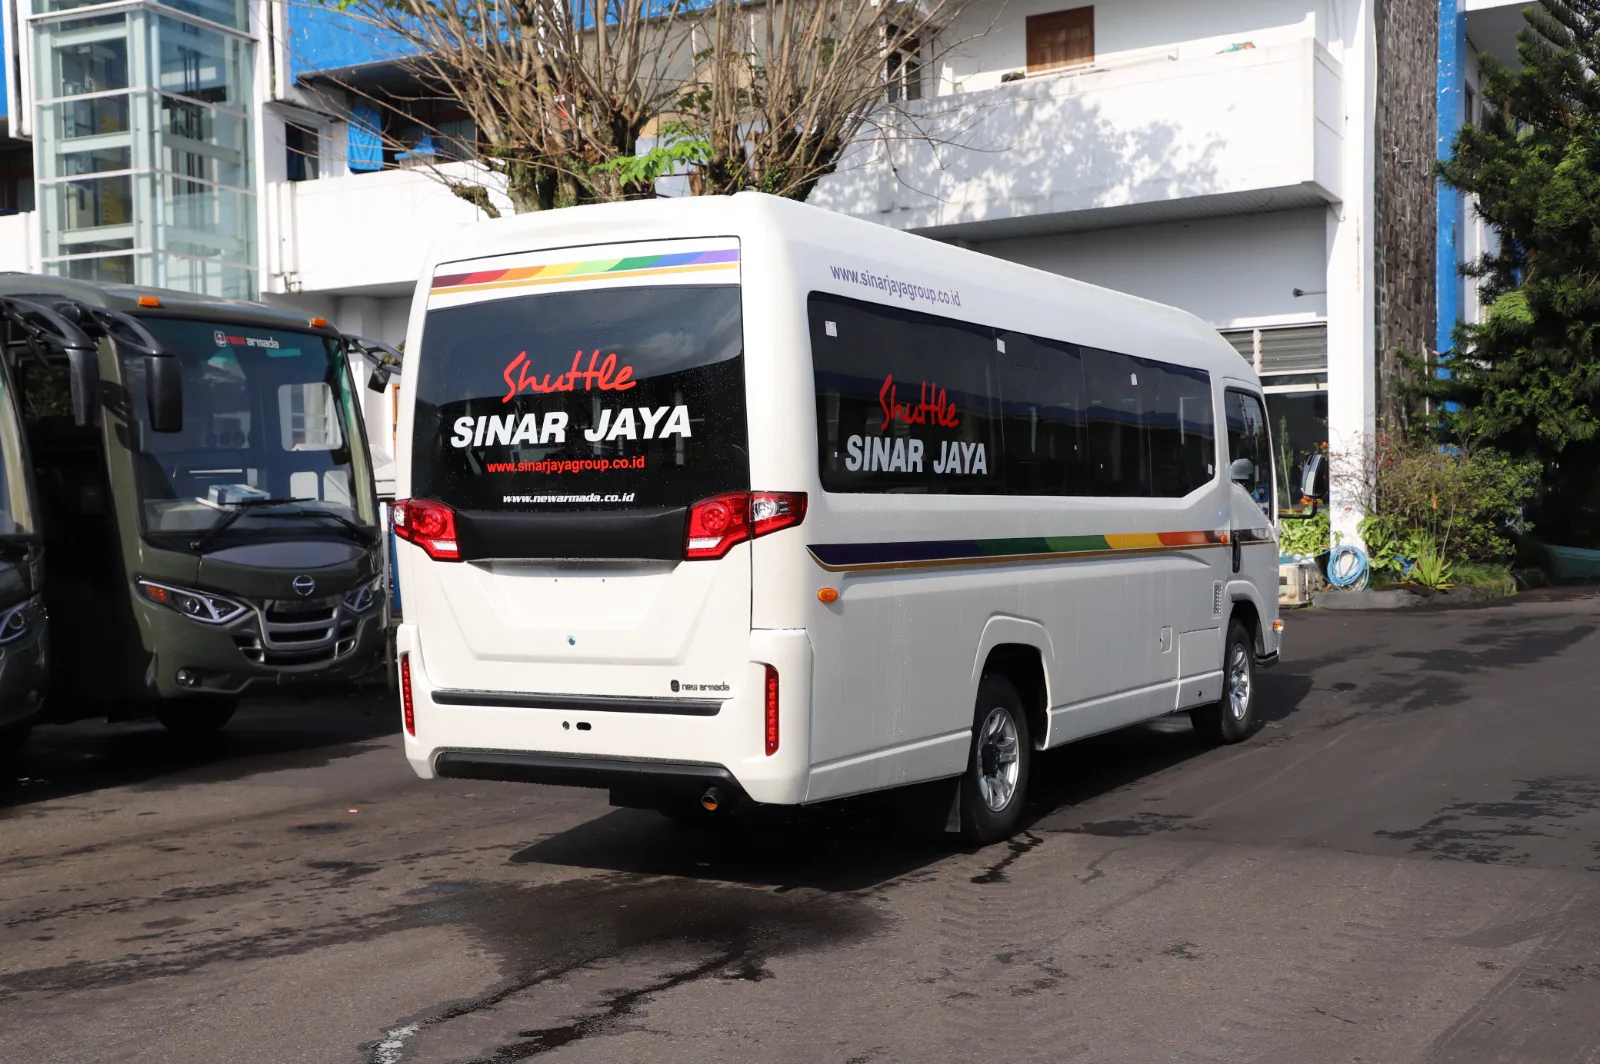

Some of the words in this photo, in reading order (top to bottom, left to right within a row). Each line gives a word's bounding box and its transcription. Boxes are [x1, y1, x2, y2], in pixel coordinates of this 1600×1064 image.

[830, 264, 961, 307] www.sinarjayagroup.co.id
[246, 336, 279, 349] armada
[503, 350, 637, 403] Shuttle
[880, 374, 960, 431] Shuttle
[450, 411, 569, 448] SINAR
[584, 404, 692, 443] JAYA
[487, 456, 646, 475] www.sinarjayagroup.co.id
[845, 434, 924, 473] SINAR
[933, 440, 988, 475] JAYA
[502, 493, 636, 504] www.newarmada.co.id
[699, 681, 730, 691] armada
